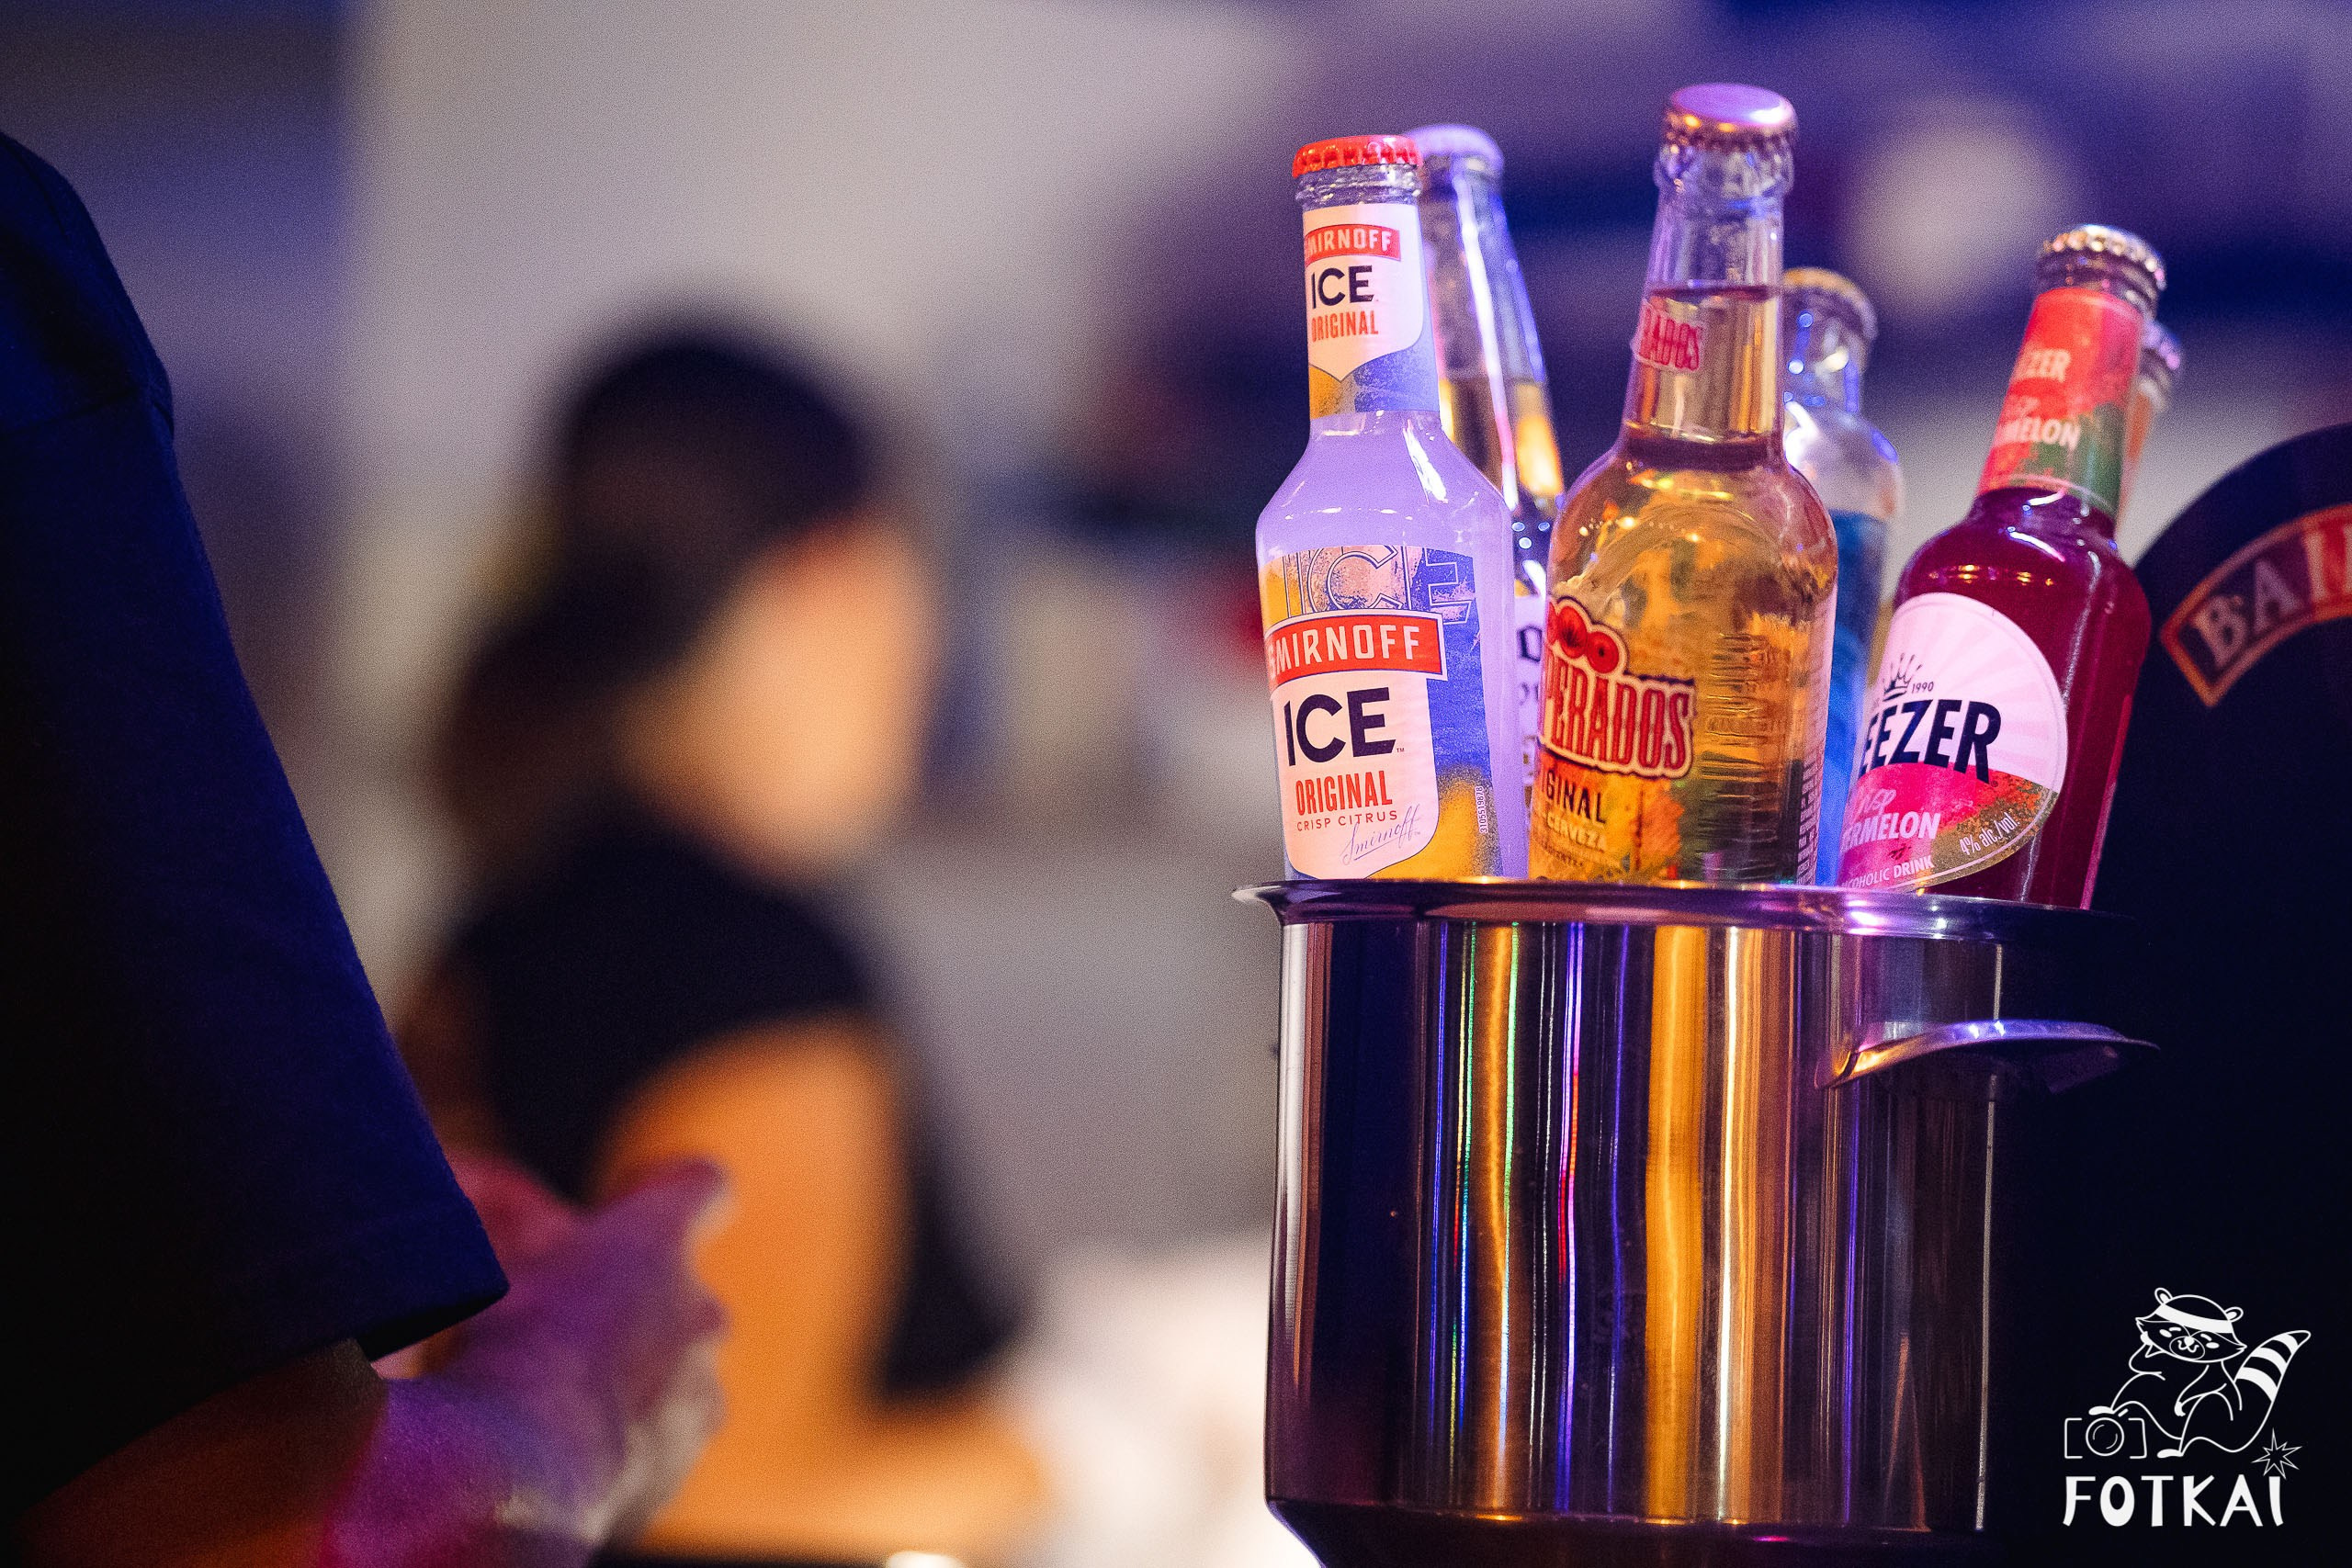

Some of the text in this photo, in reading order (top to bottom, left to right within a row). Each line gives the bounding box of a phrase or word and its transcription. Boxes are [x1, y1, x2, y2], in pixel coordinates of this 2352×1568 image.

[1305, 228, 1392, 256] MIRNOFF
[1311, 265, 1374, 310] ICE
[1311, 310, 1379, 343] ORIGINAL
[1911, 681, 1935, 695] 1990
[1283, 686, 1396, 767] ICE
[1295, 770, 1393, 816] ORIGINAL
[1297, 809, 1398, 831] CRISP CITRUS
[1959, 834, 1982, 856] 4%
[1893, 855, 1936, 879] DRINK
